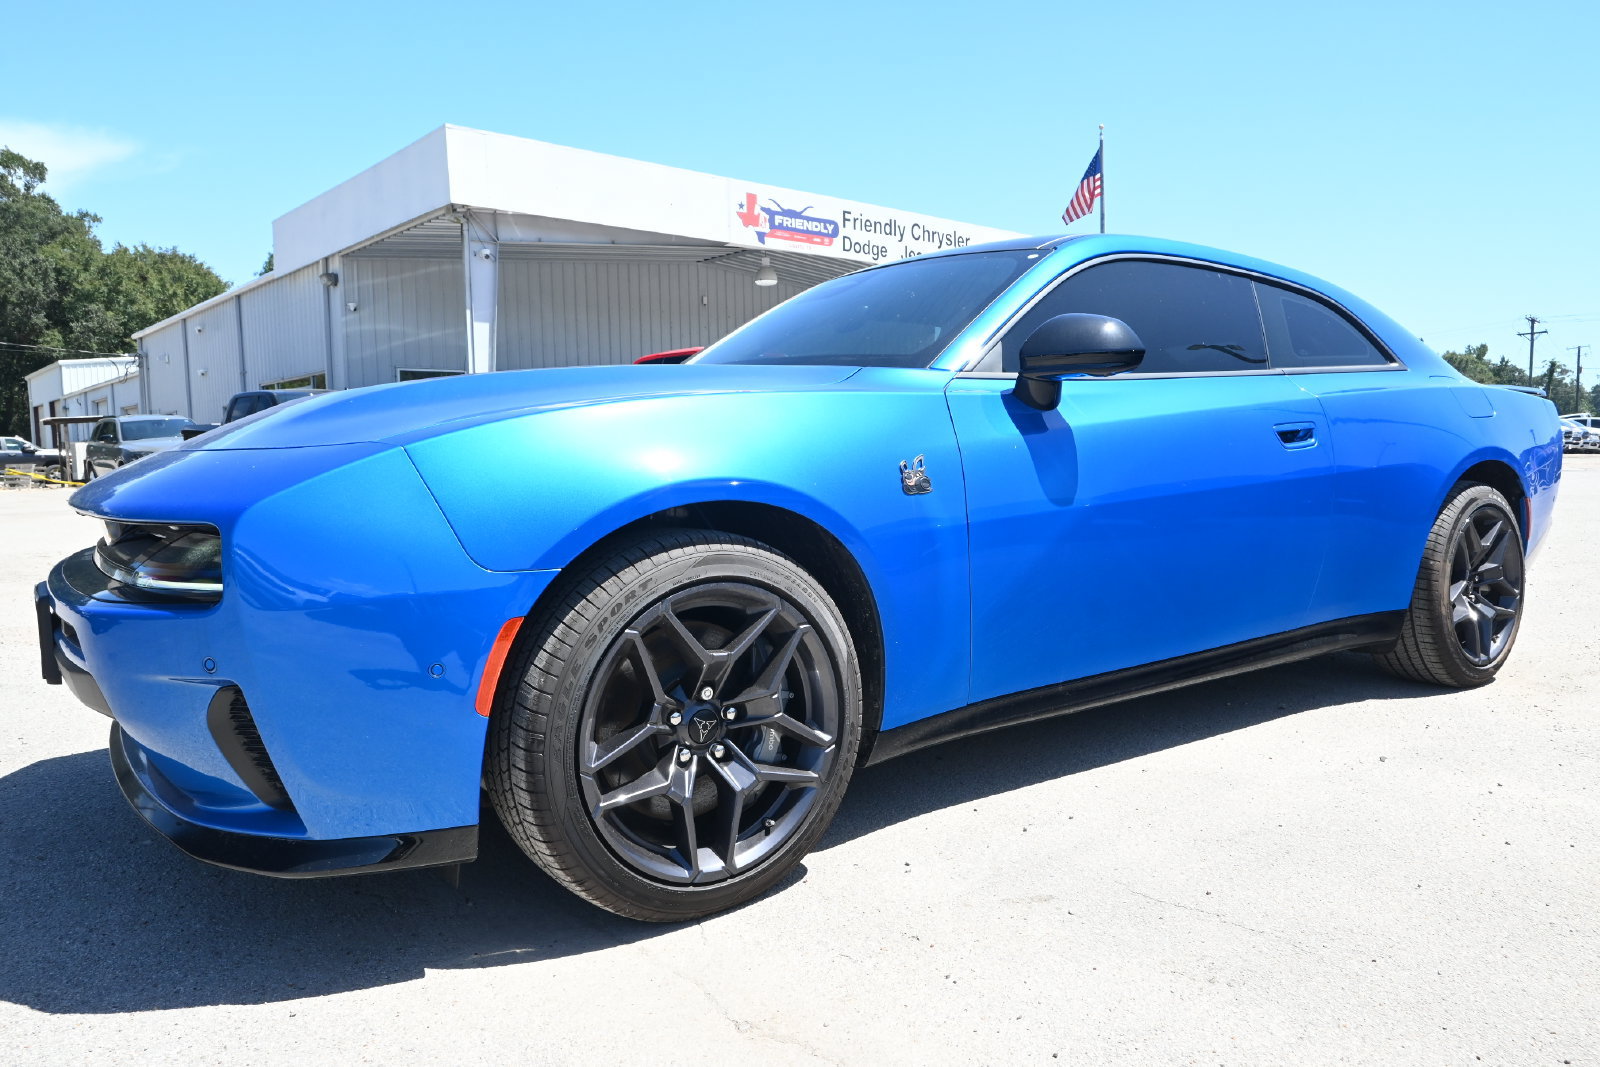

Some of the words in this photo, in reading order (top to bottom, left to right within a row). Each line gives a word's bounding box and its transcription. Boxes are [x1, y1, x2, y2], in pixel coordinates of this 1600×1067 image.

[774, 214, 835, 234] FRIENDLY
[842, 210, 906, 242] Friendly
[911, 223, 971, 249] Chrysler
[842, 235, 888, 260] Dodge
[584, 577, 653, 649] SPORT
